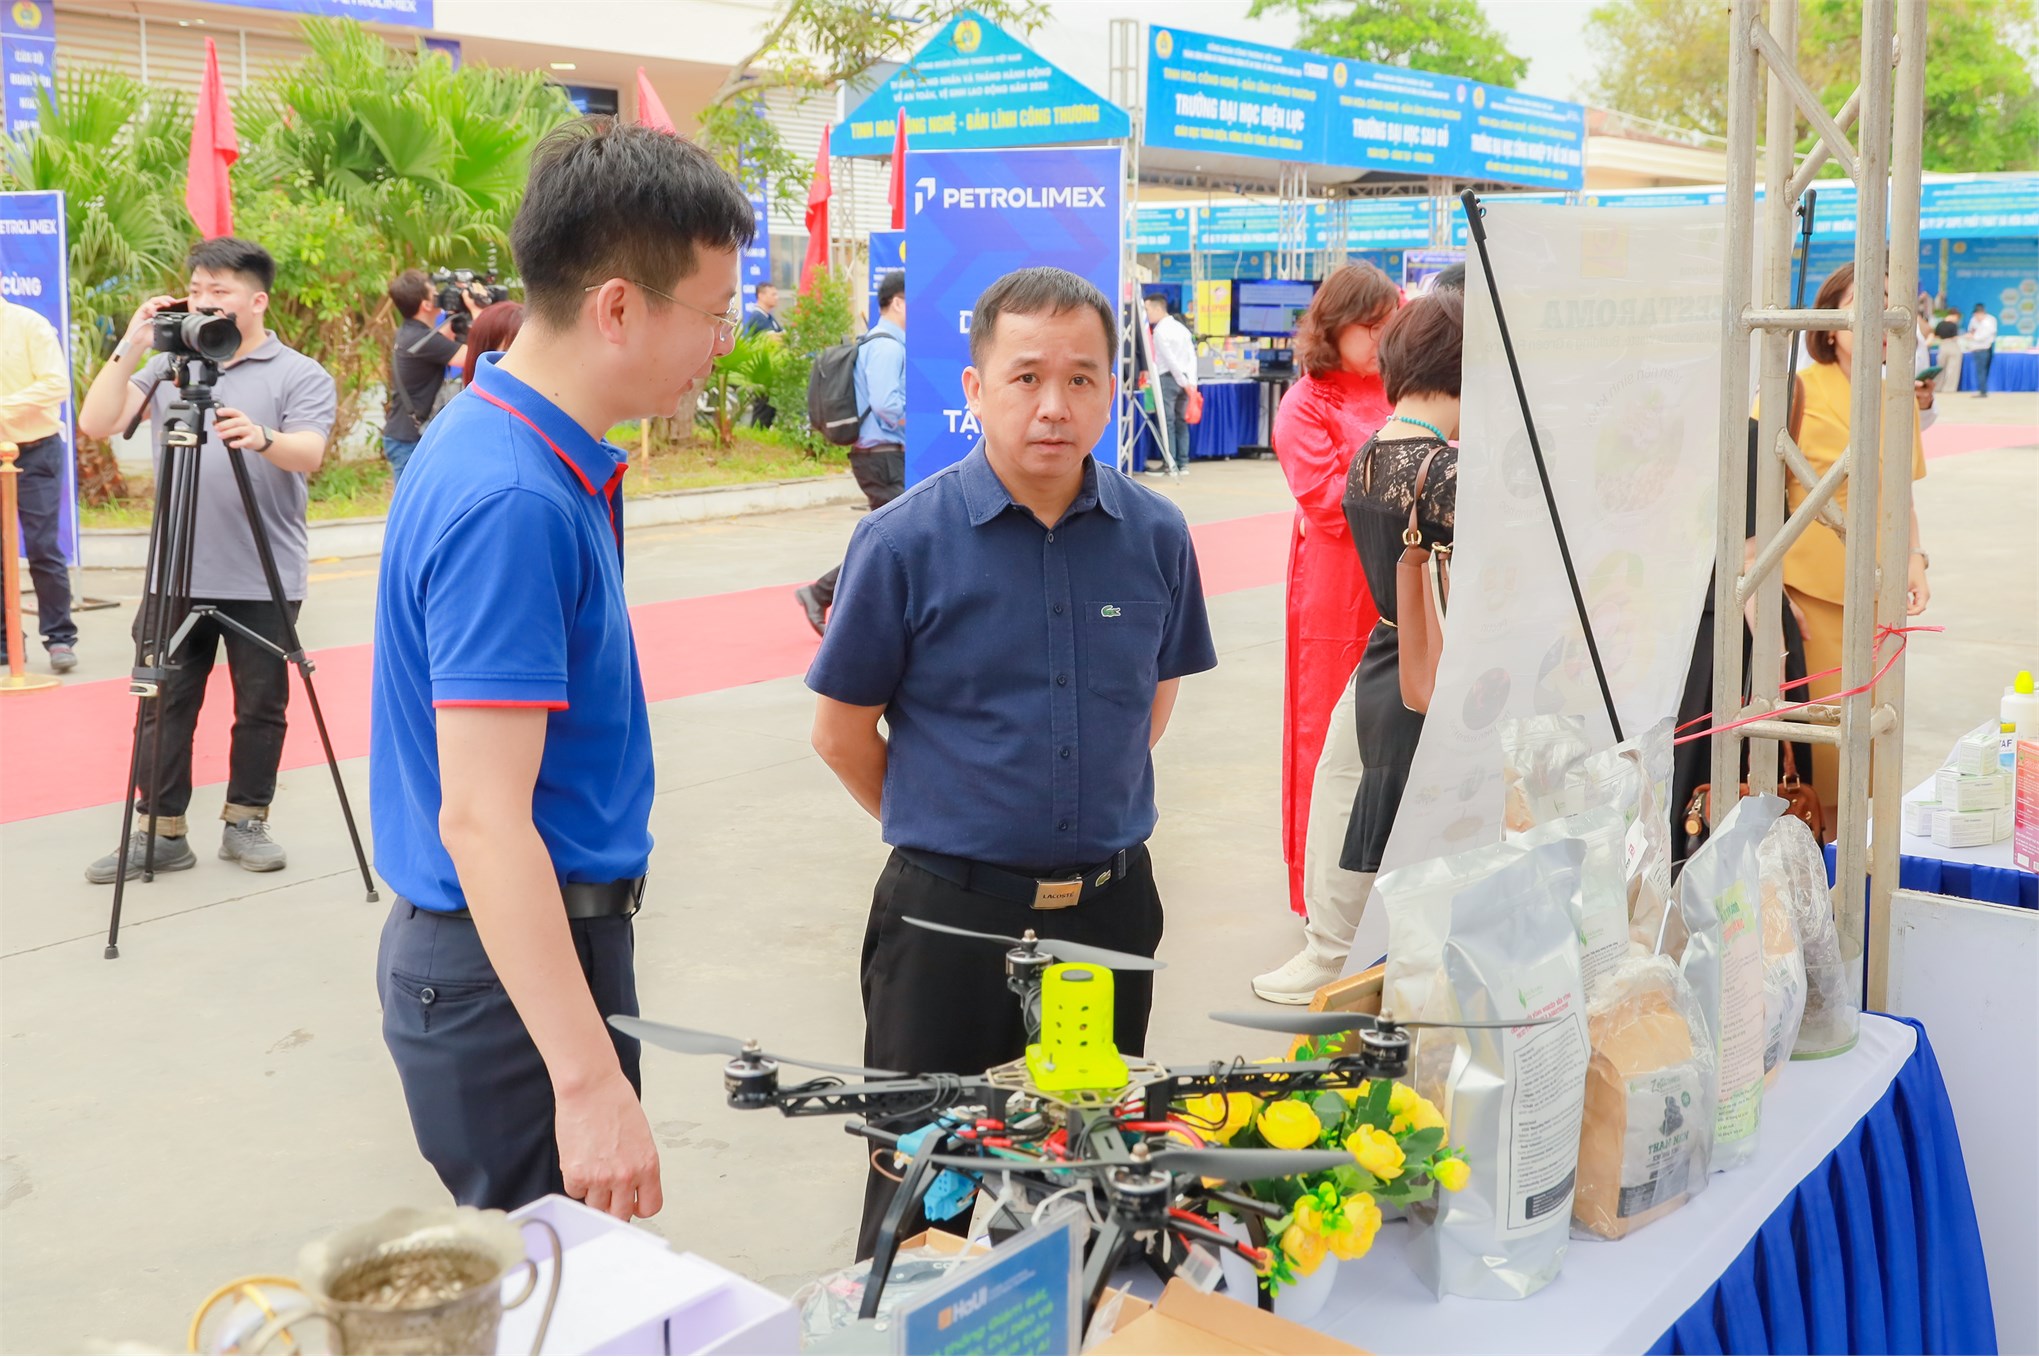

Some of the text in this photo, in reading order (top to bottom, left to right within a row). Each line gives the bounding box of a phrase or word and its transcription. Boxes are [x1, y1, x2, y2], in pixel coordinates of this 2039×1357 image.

[903, 115, 927, 135] ÔNG
[1020, 105, 1051, 127] CÔNG
[943, 186, 1106, 209] PETROLIMEX
[0, 219, 57, 234] ETROLIMEX
[3, 271, 42, 296] CÙNG
[1042, 891, 1075, 899] LACOSTE
[952, 1285, 988, 1323] HaUI
